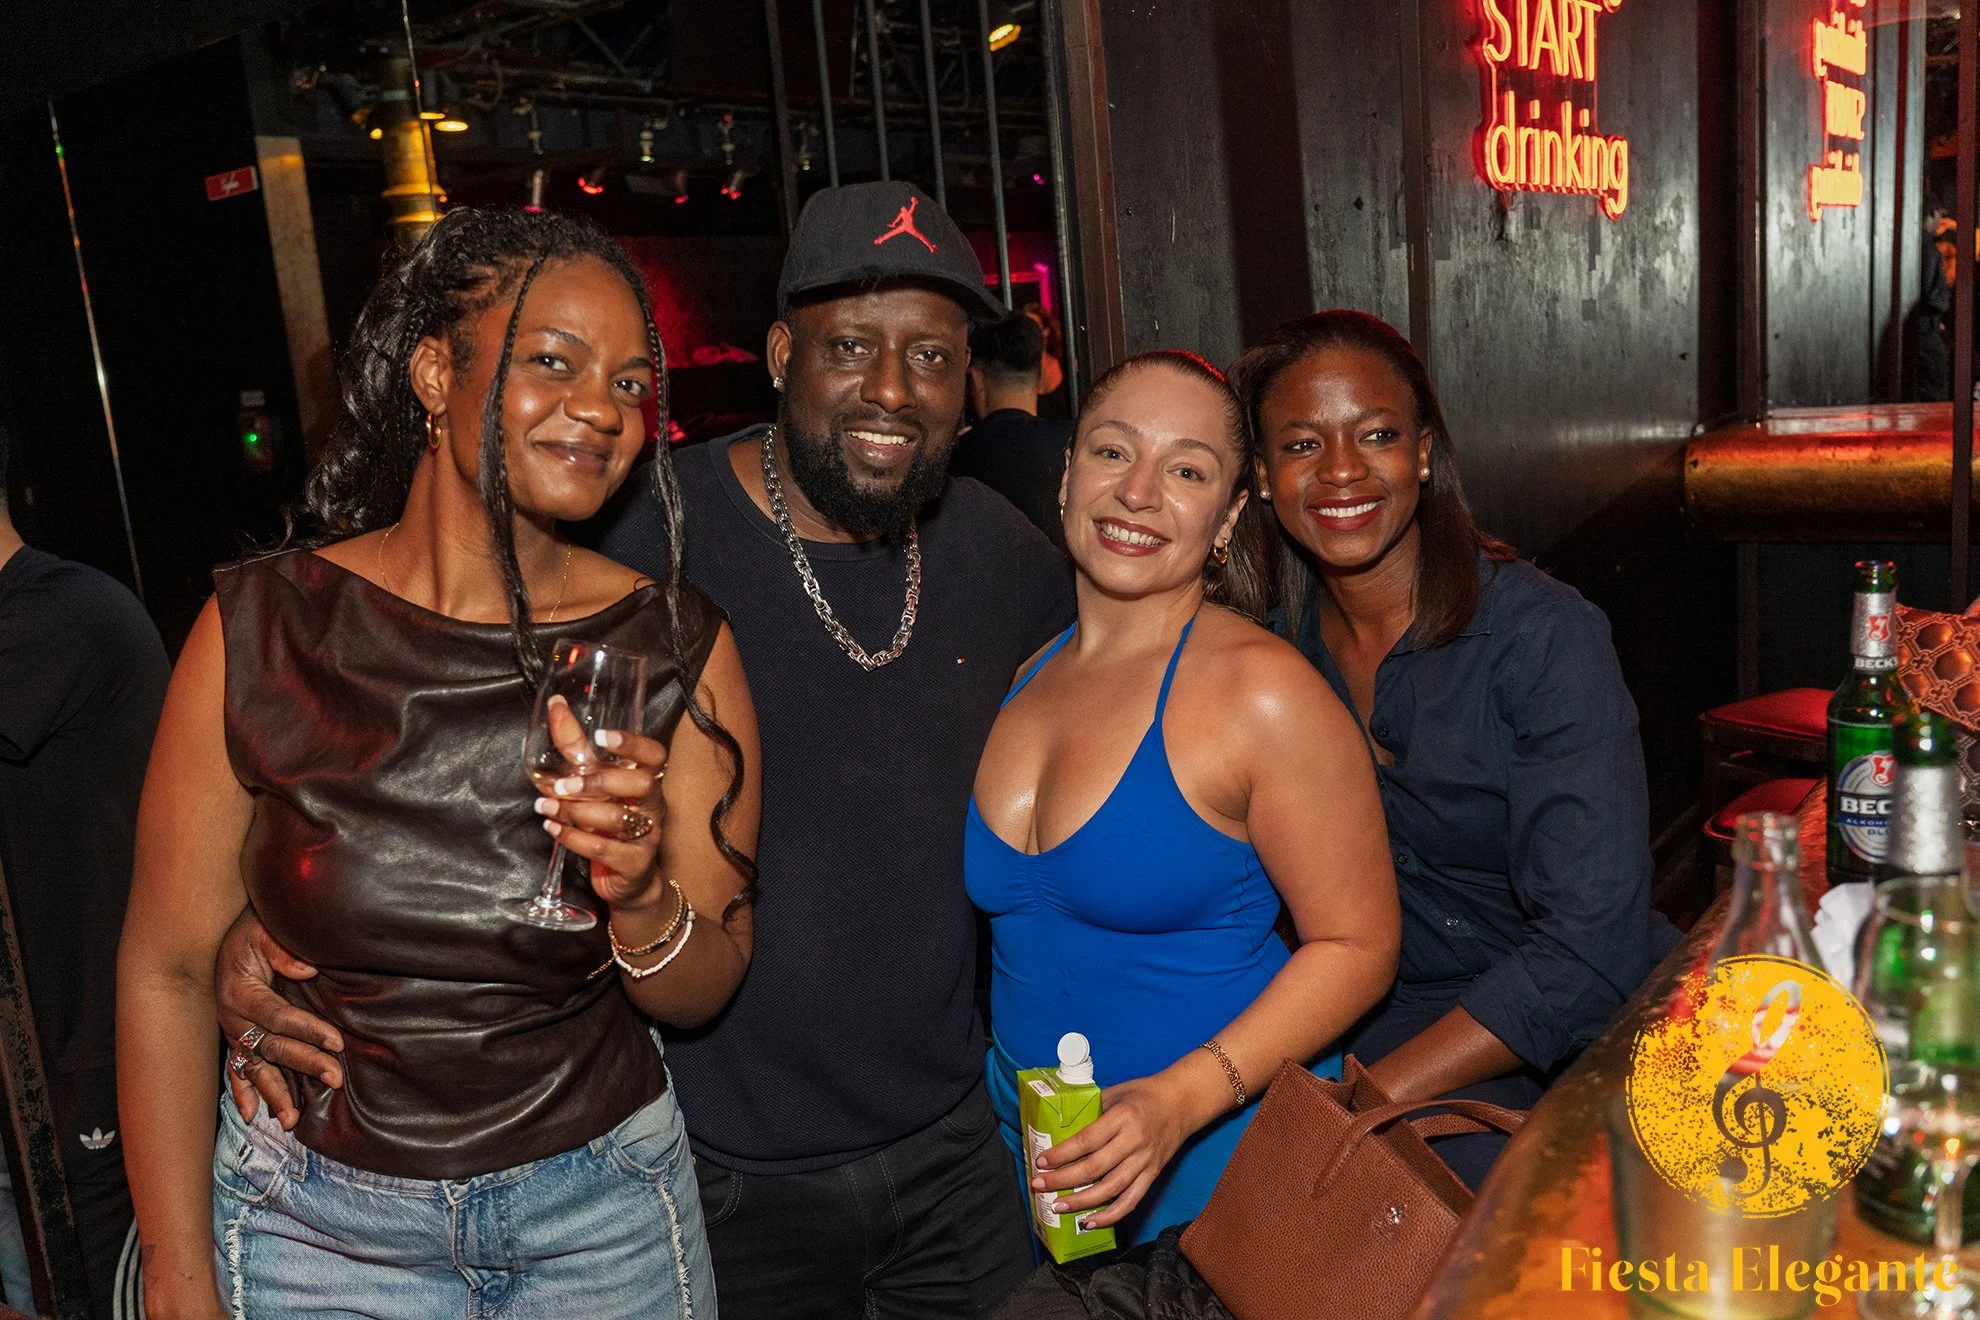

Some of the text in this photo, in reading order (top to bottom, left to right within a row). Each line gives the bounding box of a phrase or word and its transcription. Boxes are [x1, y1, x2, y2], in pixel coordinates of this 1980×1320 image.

[1486, 0, 1603, 82] START
[1489, 90, 1628, 214] drinking
[1840, 796, 1892, 815] BEC
